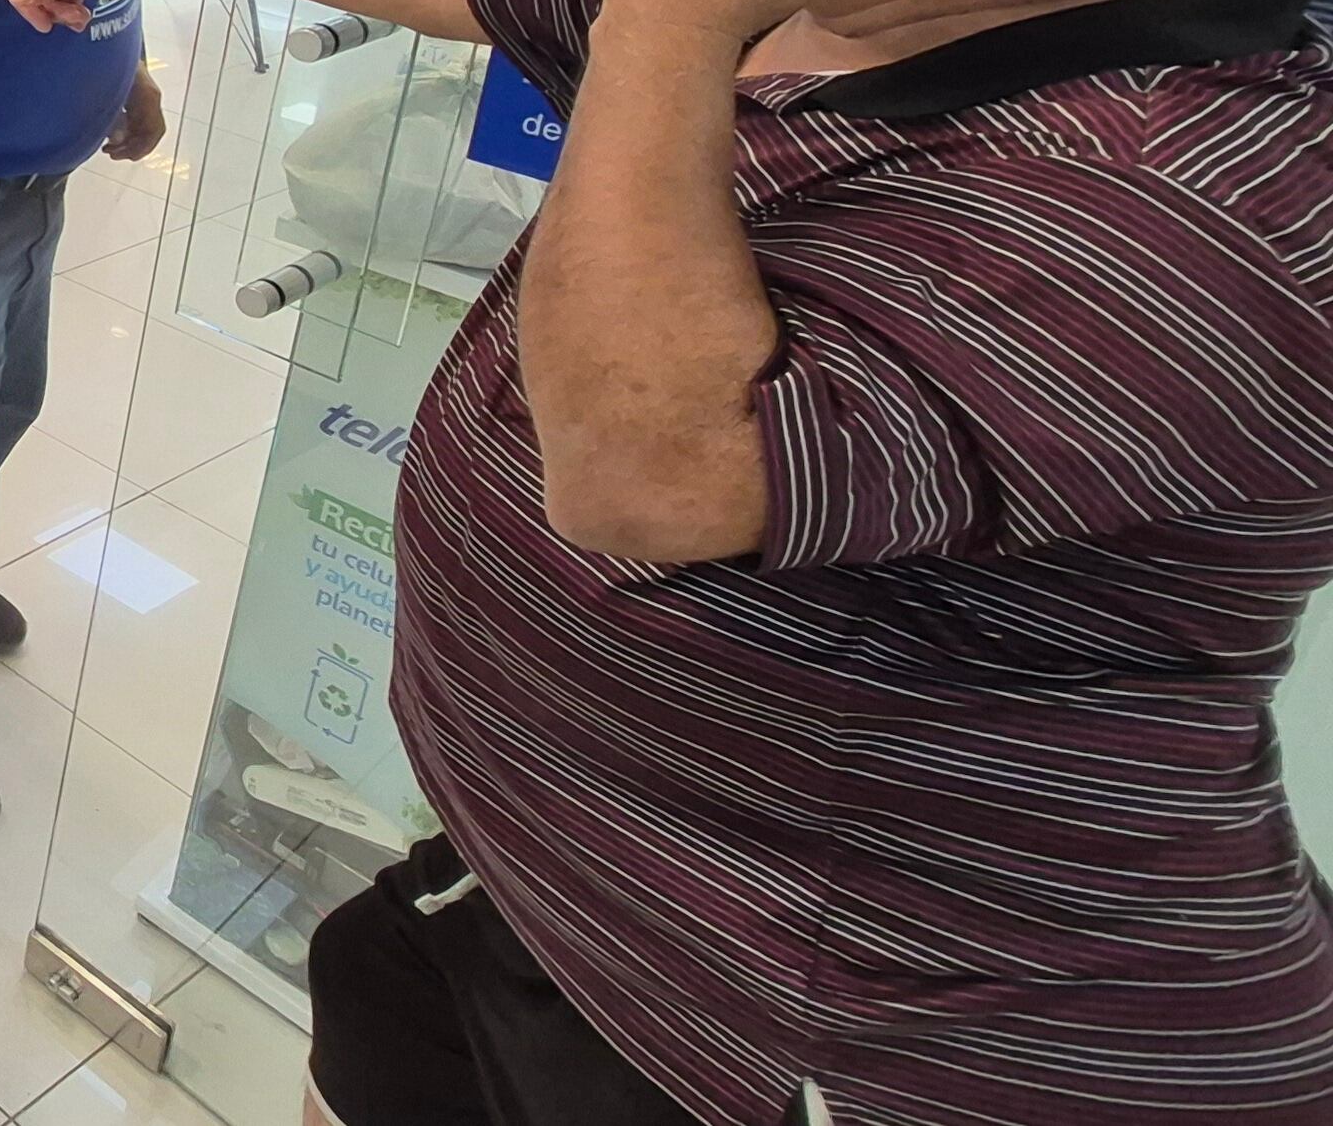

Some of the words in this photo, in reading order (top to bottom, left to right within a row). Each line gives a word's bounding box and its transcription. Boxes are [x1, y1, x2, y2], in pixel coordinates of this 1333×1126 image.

[522, 114, 562, 141] de
[312, 534, 338, 559] tu
[305, 557, 322, 578] y
